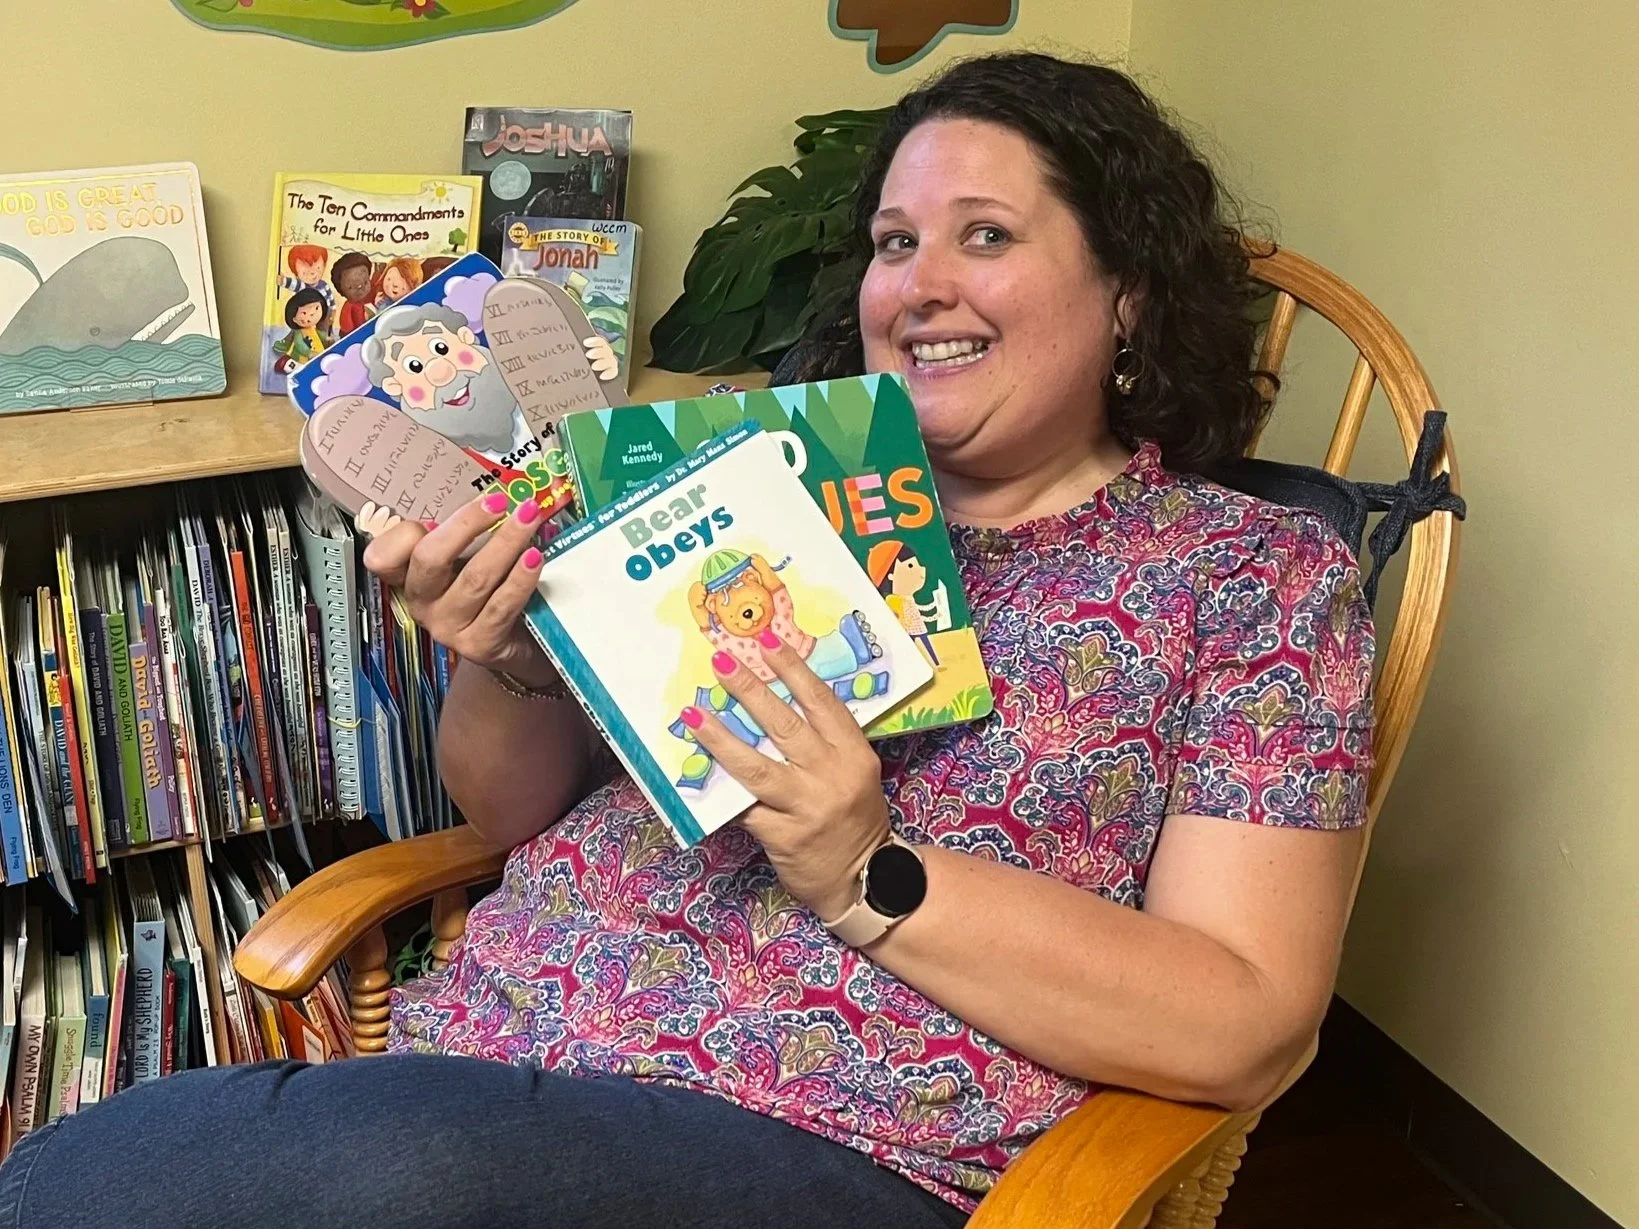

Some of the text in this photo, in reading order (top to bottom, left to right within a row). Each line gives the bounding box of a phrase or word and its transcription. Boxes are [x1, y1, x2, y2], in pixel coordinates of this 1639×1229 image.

[482, 115, 614, 157] JOSHUA
[0, 182, 157, 215] OD IS GREAT
[287, 193, 465, 222] The Ten Commandments
[26, 205, 184, 237] GOD IS GOOD
[313, 218, 429, 243] for Little Ones
[533, 231, 553, 242] THE
[556, 231, 588, 241] STORY
[533, 244, 599, 271] Jonah
[471, 421, 555, 491] The Story of
[622, 451, 663, 466] Kennedy
[627, 441, 653, 454] Jared
[619, 483, 707, 549] Bear
[625, 504, 734, 581] Obeys
[270, 545, 278, 571] ESTHER
[282, 547, 291, 574] ESTHER
[191, 579, 201, 607] DAVID
[89, 644, 97, 659] Story
[109, 624, 128, 674] DAVID
[91, 667, 100, 689] DAVID
[118, 678, 128, 698] AND
[132, 655, 153, 711] David
[95, 690, 103, 705] AND
[97, 707, 107, 736] GOLIATH
[120, 701, 133, 741] GOLIATH
[54, 720, 67, 749] DAVID
[63, 780, 74, 804] GIAN
[139, 720, 162, 790] Goliath
[1, 794, 13, 813] DEN
[133, 798, 141, 816] Flying
[135, 968, 153, 1025] SHEPHERD
[28, 1025, 42, 1044] MY
[64, 1028, 77, 1061] Snuggle
[90, 1013, 105, 1048] found
[25, 1045, 40, 1073] OWN
[134, 1055, 149, 1078] LORD
[61, 1062, 73, 1085] Time
[19, 1077, 37, 1115] PSALM
